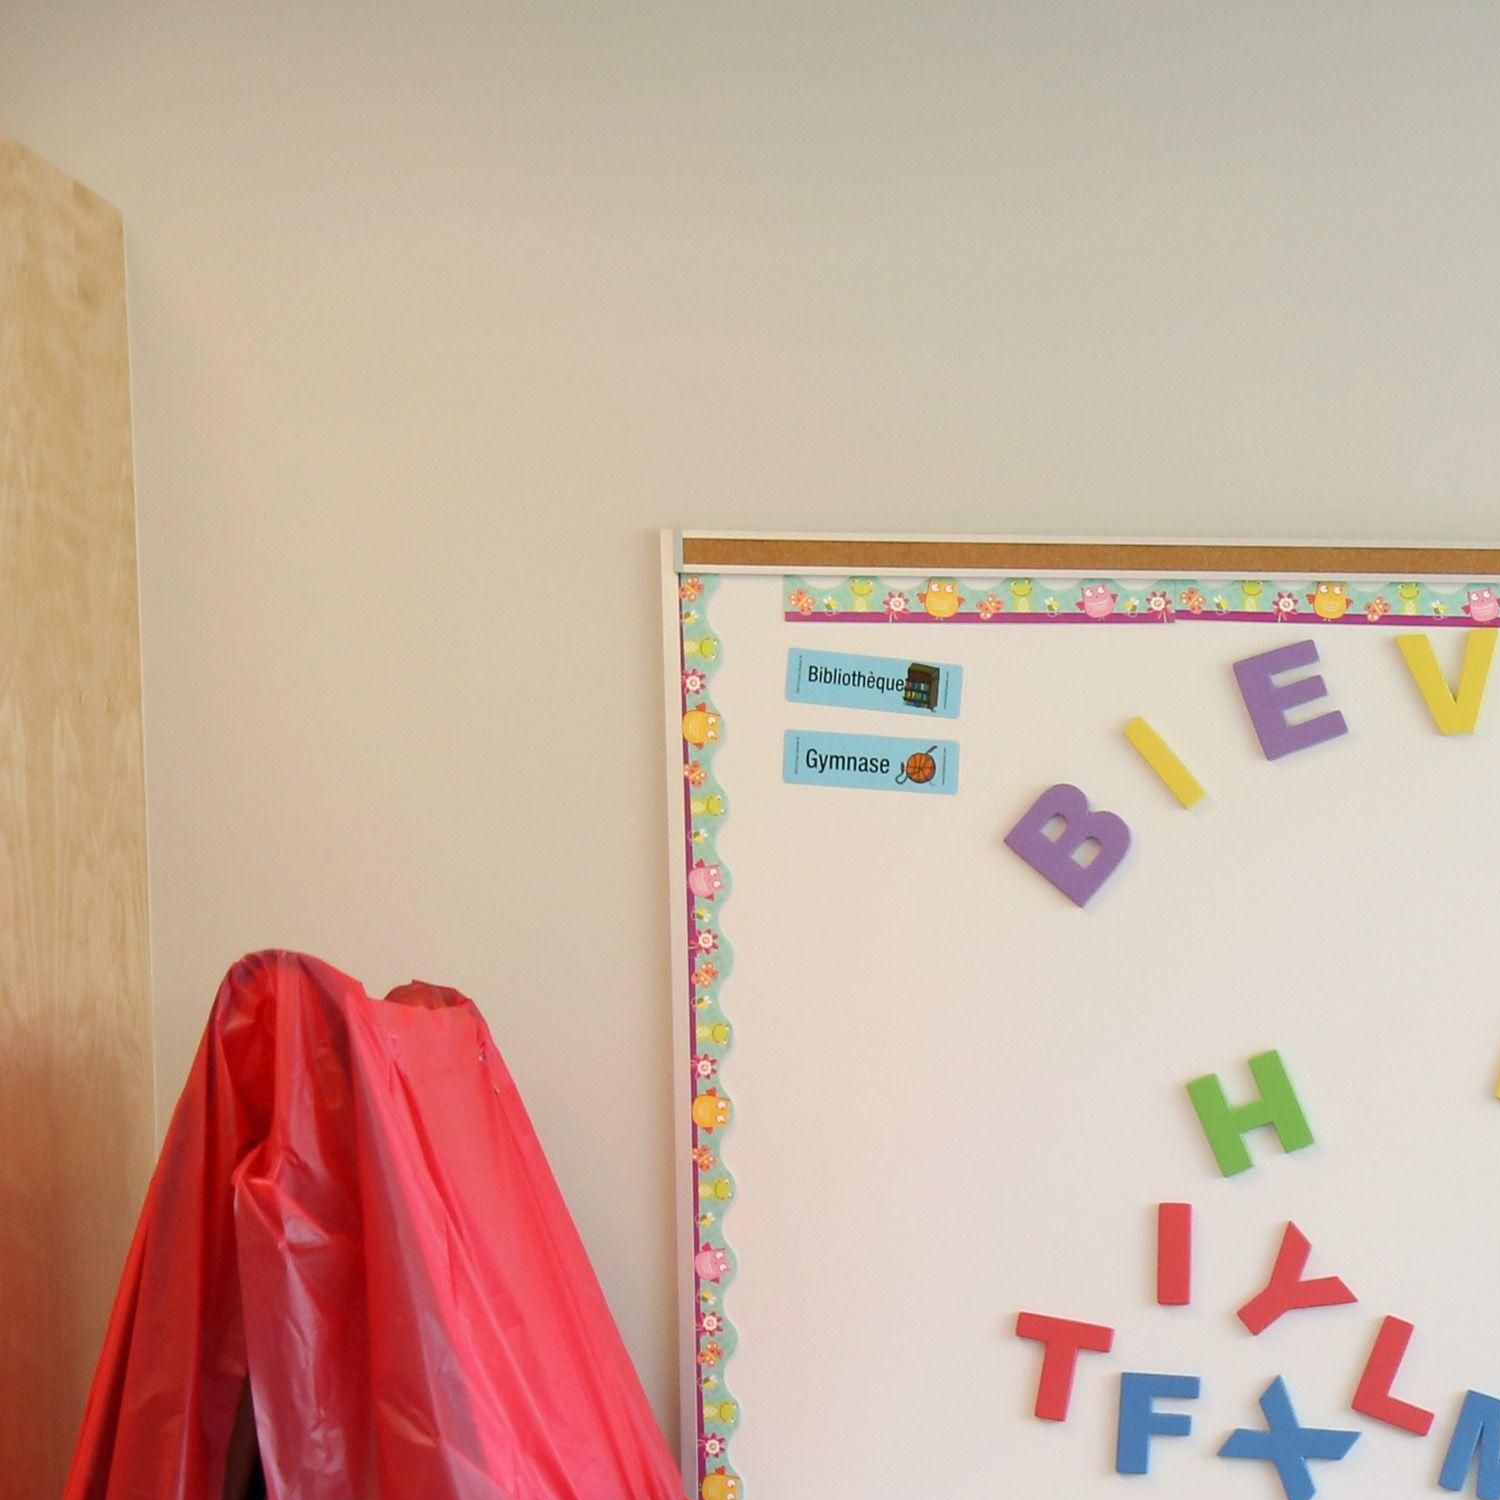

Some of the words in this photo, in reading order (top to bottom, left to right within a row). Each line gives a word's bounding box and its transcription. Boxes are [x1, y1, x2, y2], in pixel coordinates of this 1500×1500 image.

[807, 664, 905, 694] Bibliothèque
[805, 747, 891, 774] Gymnase
[1186, 1049, 1314, 1178] H
[1014, 1311, 1115, 1422] T
[1350, 1314, 1435, 1437] L
[1115, 1371, 1201, 1475] F
